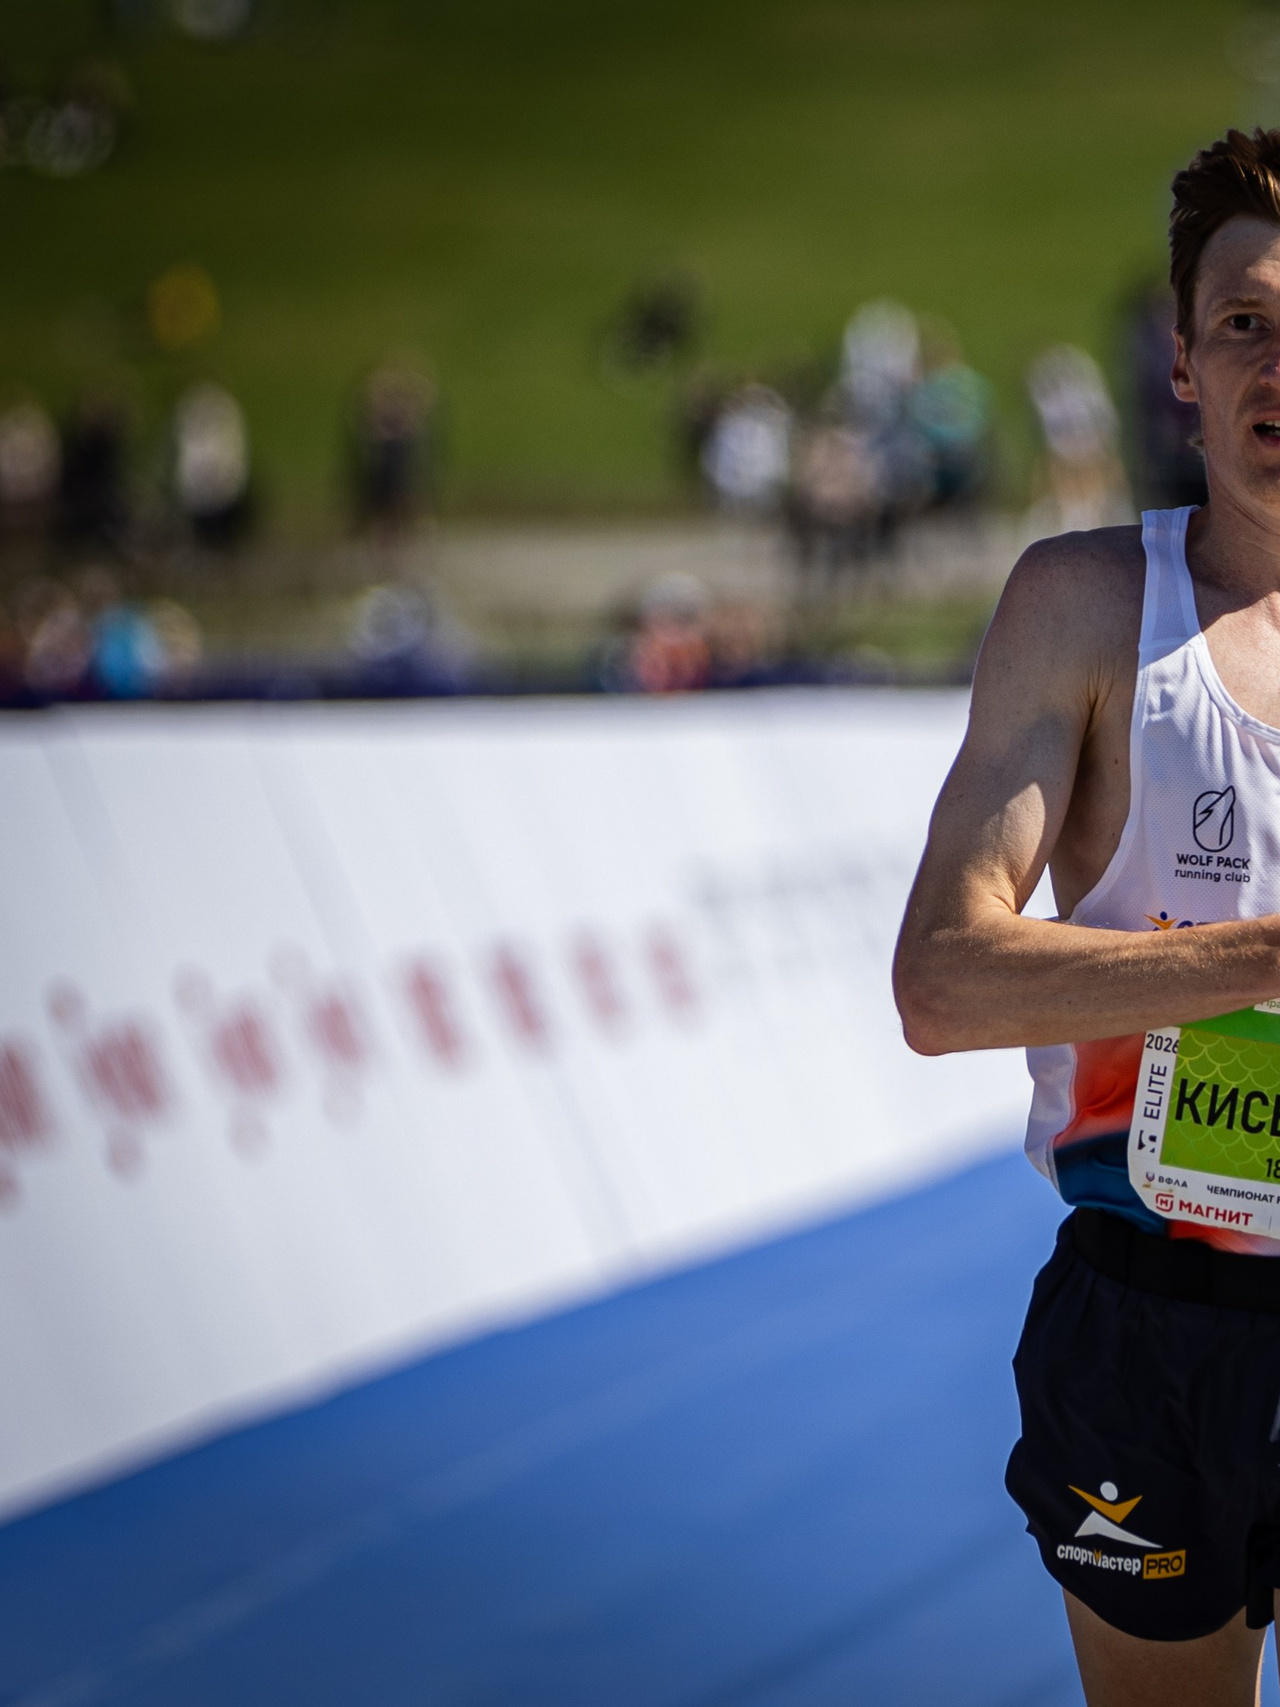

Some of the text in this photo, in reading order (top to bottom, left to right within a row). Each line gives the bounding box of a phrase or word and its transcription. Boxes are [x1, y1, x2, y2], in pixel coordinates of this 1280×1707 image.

[1176, 853, 1250, 870] WOLF PACK
[1175, 869, 1251, 883] running club
[1143, 1063, 1167, 1120] ELITE
[1158, 1175, 1188, 1188] ВФЛА
[1206, 1184, 1275, 1203] ЧЕМПИОНАТ
[1179, 1199, 1254, 1226] МАГНИТ
[1146, 1555, 1183, 1575] PRO
